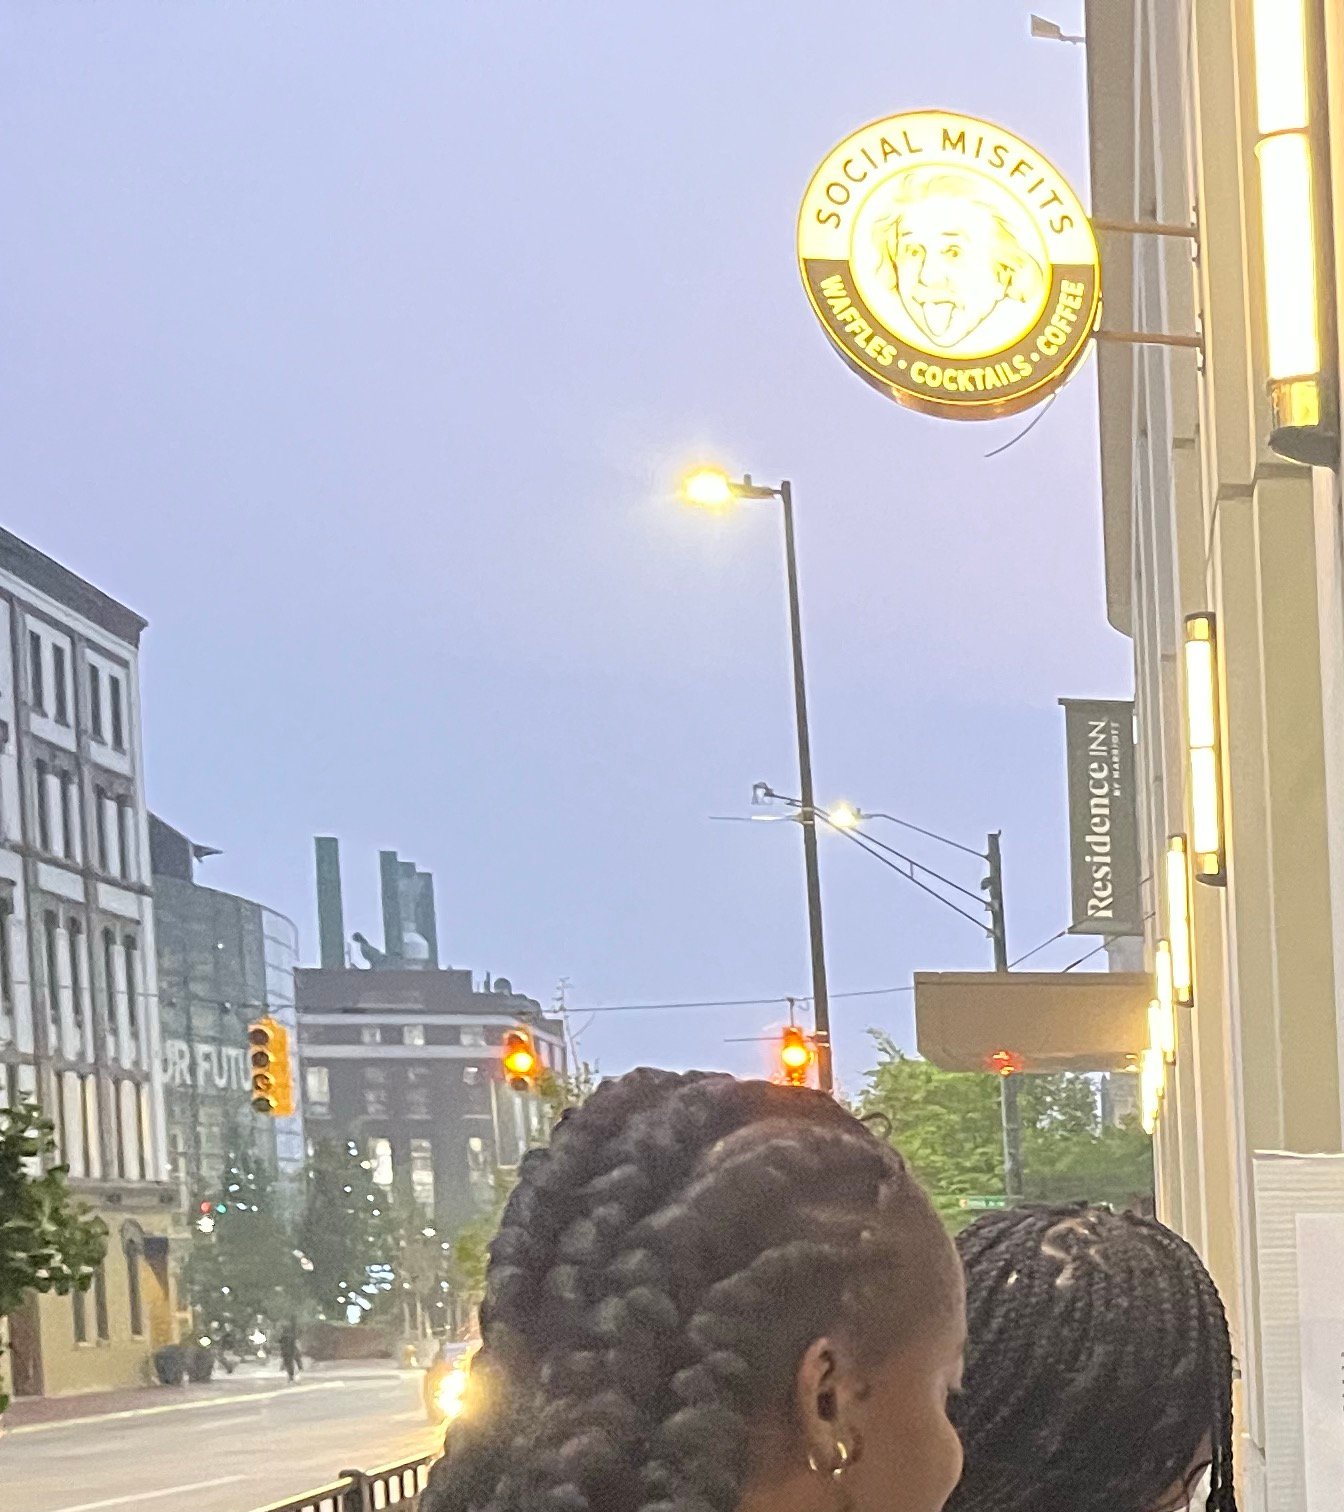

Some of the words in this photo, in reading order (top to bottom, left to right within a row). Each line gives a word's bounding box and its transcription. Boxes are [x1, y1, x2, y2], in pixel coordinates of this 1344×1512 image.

[816, 131, 922, 230] SOCIAL
[941, 128, 1073, 235] MISFITS
[820, 275, 898, 367] WAFFLES
[910, 354, 1033, 392] COCKTAILS
[1036, 279, 1084, 356] COFFEE
[1088, 721, 1108, 756] INN
[1085, 761, 1113, 917] Residence
